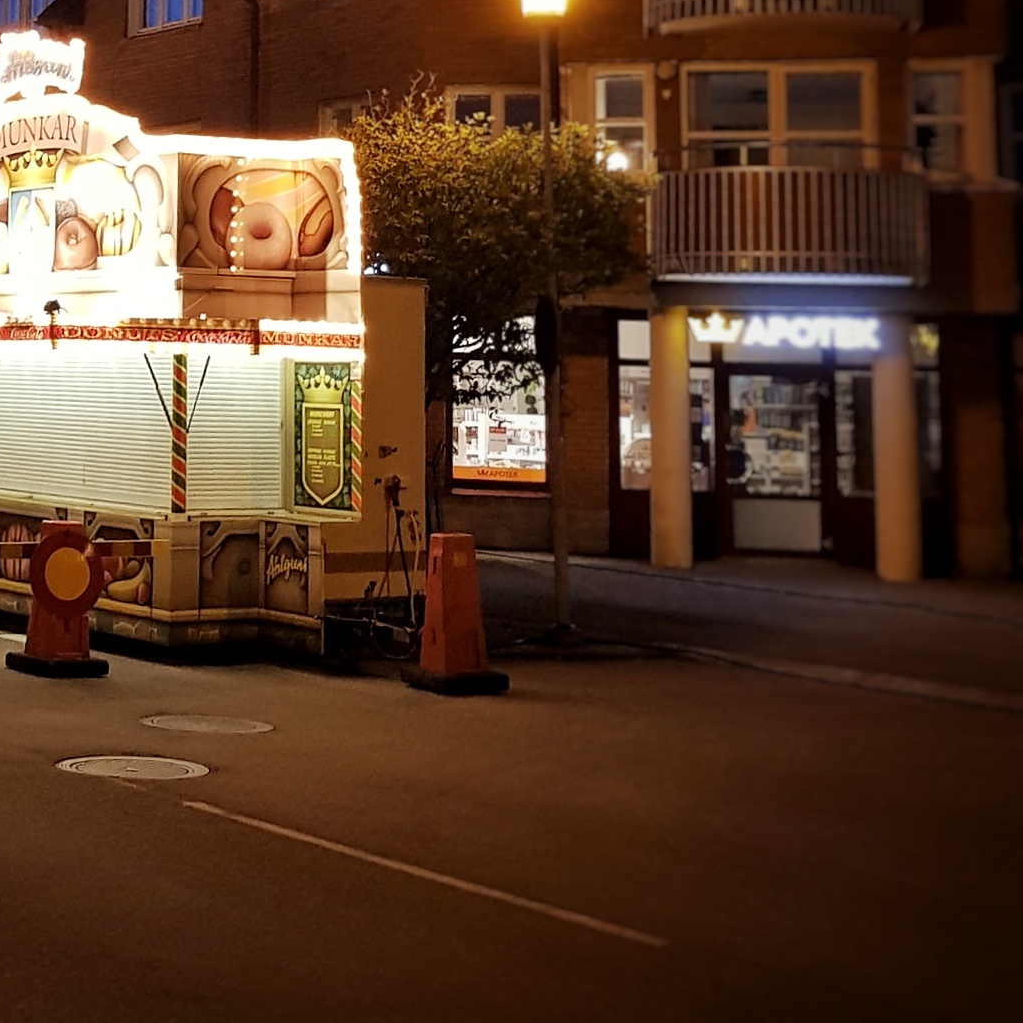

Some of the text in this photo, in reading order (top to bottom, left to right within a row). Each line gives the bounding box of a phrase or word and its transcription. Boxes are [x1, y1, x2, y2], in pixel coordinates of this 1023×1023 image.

[263, 331, 359, 348] MUNKAR
[742, 315, 880, 350] APOTEK
[489, 469, 520, 478] APOTEK
